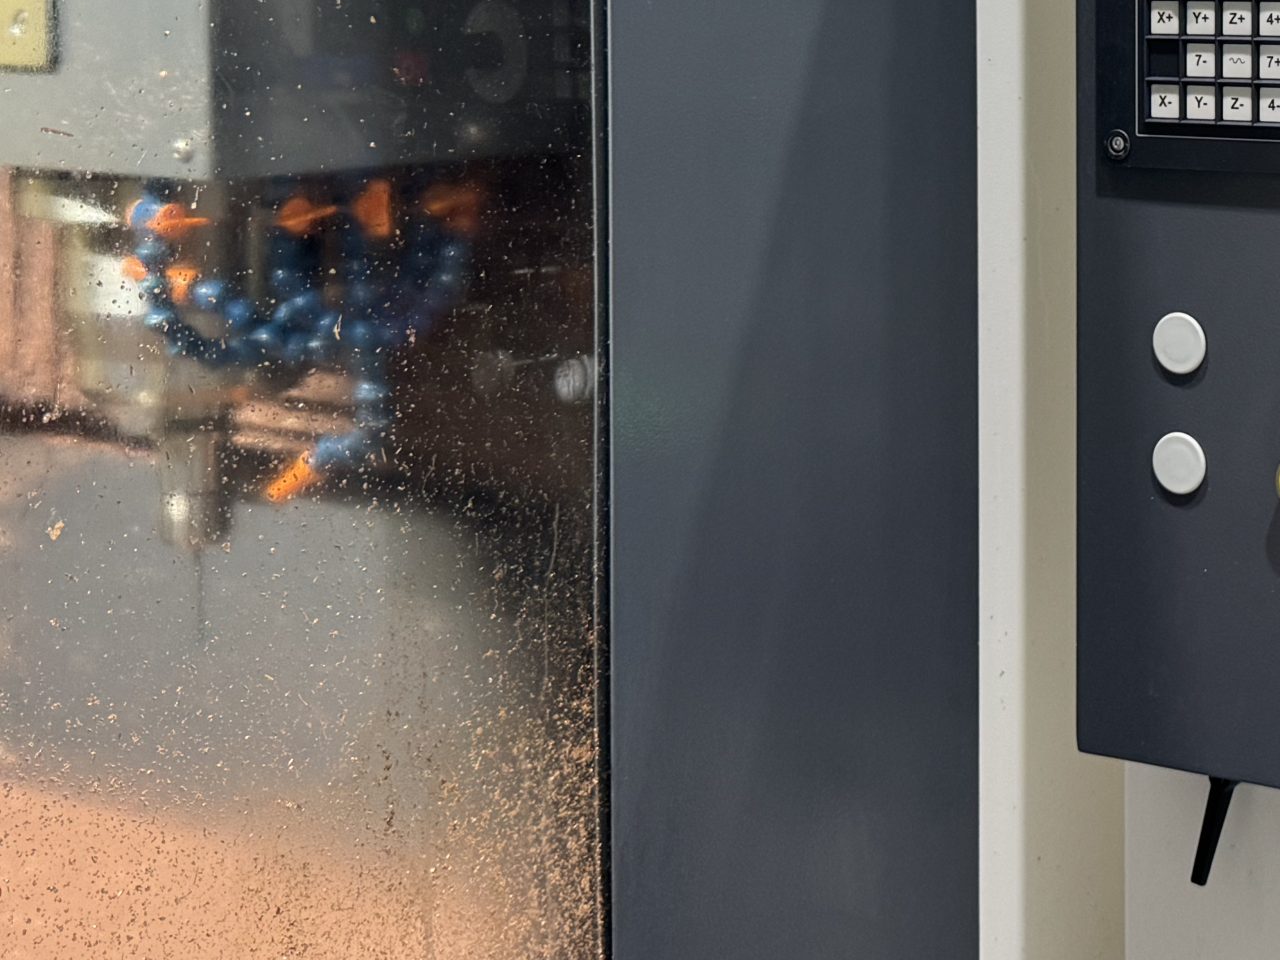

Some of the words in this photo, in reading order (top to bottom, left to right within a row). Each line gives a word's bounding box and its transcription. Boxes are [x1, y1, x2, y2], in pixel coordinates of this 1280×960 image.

[1157, 12, 1173, 23] X+
[1193, 12, 1209, 23] Y+
[1229, 13, 1245, 24] Z+
[1195, 55, 1207, 66] 7-
[1159, 96, 1172, 107] X-
[1195, 96, 1207, 108] Y-
[1231, 98, 1244, 109] Z-
[1268, 99, 1280, 110] 4-
